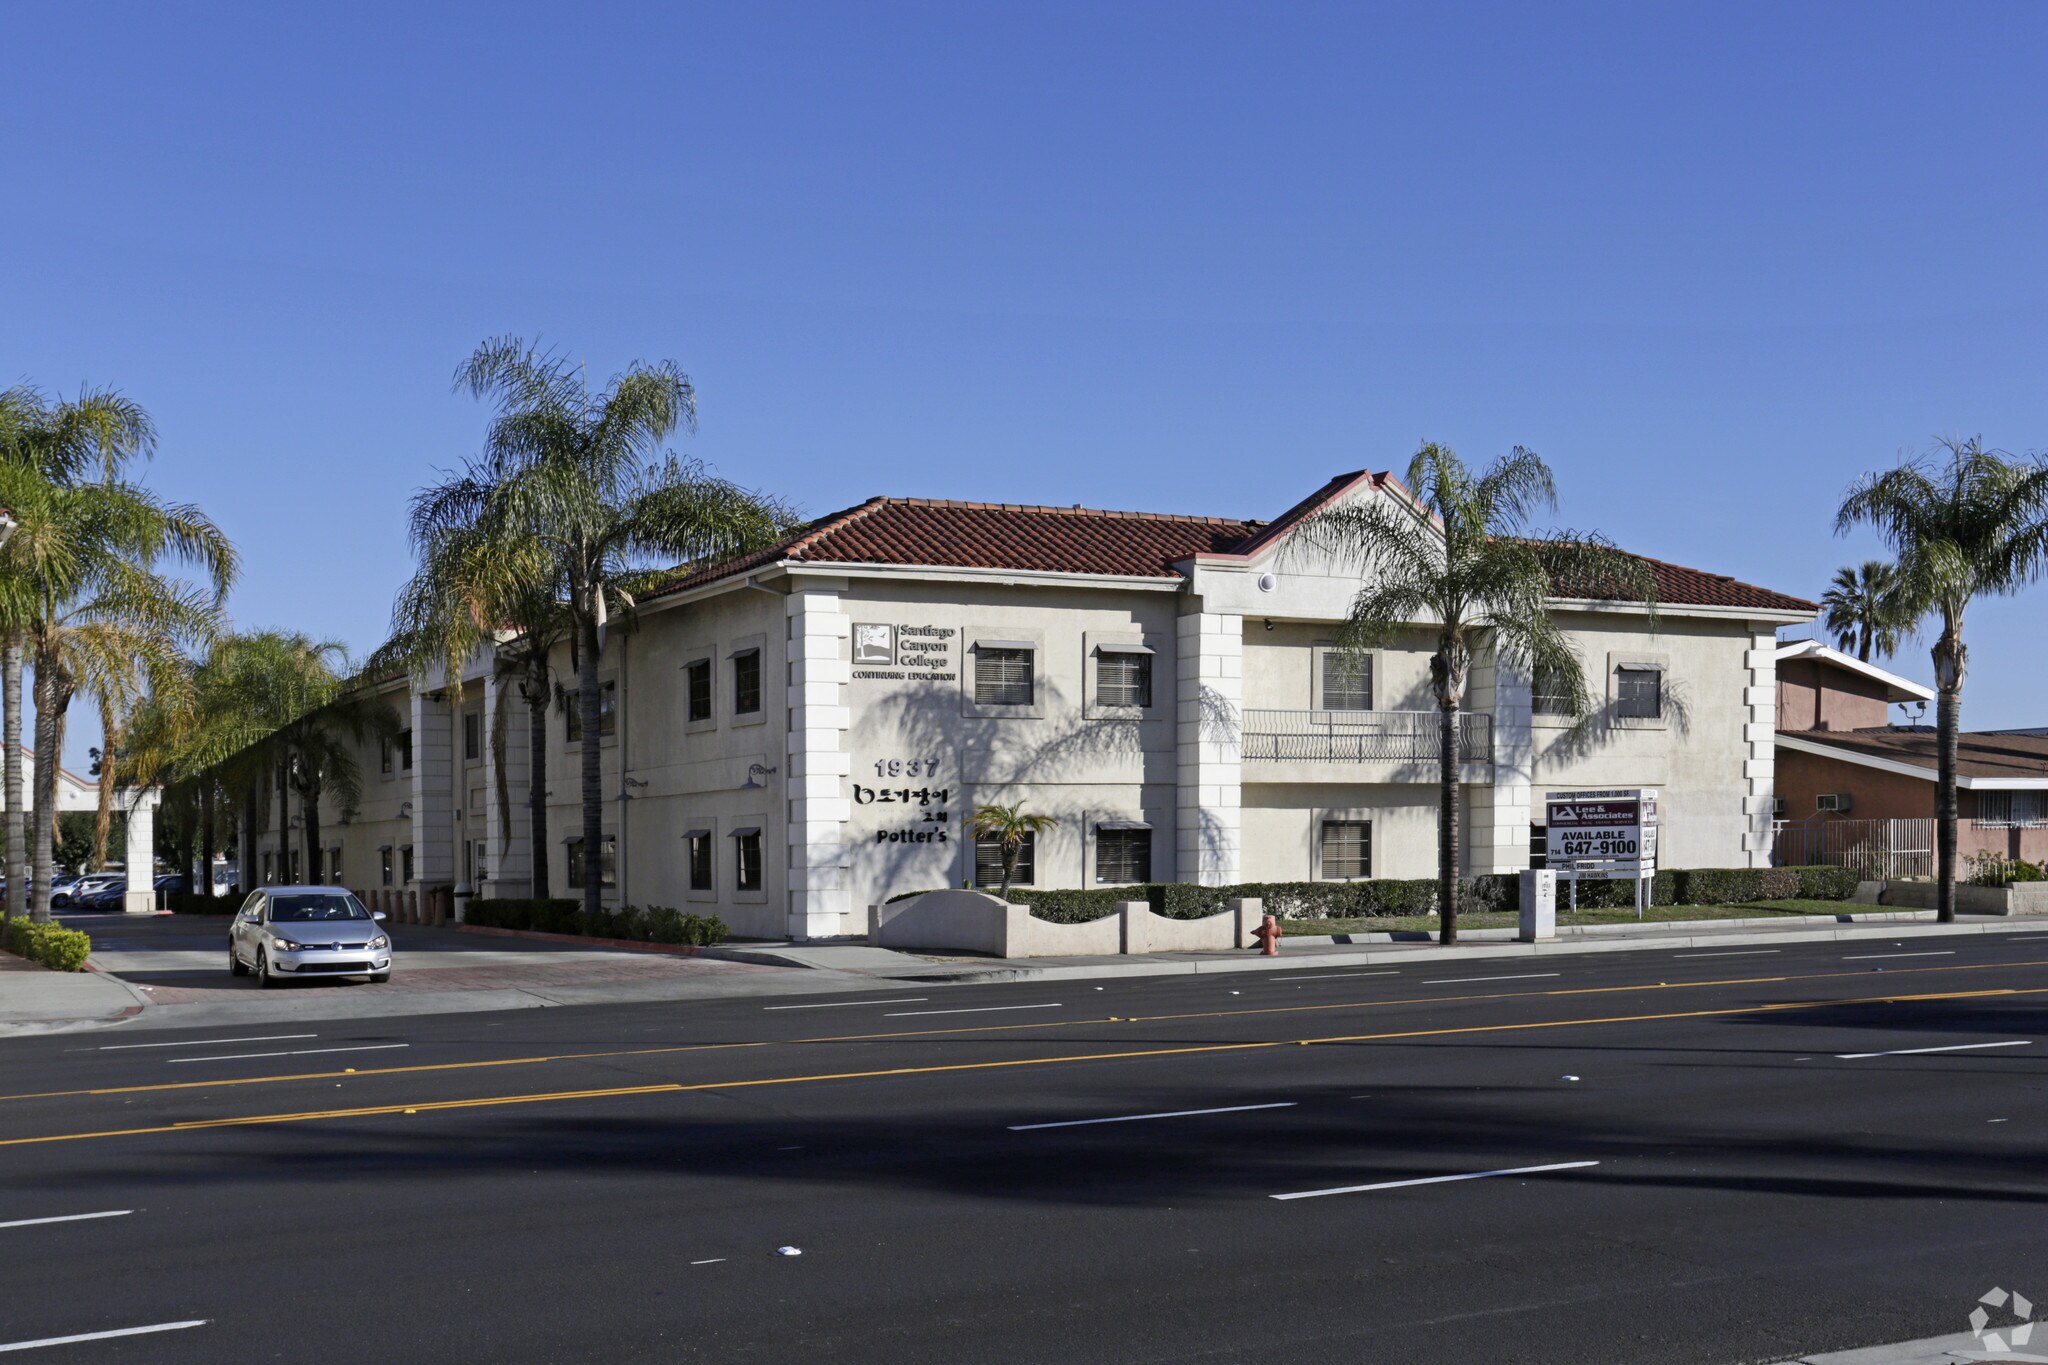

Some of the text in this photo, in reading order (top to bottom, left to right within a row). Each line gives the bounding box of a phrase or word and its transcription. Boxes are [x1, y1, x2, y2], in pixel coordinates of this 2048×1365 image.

[900, 624, 956, 640] Santiago
[900, 639, 948, 654] Canyon
[900, 654, 948, 669] College
[852, 670, 956, 681] CONTINUING EDUCATION
[874, 758, 940, 778] 1937
[1576, 791, 1596, 799] OFFICES
[1596, 790, 1611, 798] FROM
[1575, 805, 1606, 813] Lee &
[1581, 812, 1634, 820] Associates
[876, 826, 948, 844] Potter's
[1561, 831, 1626, 841] AVAILABLE
[1564, 840, 1637, 855] 647-9100
